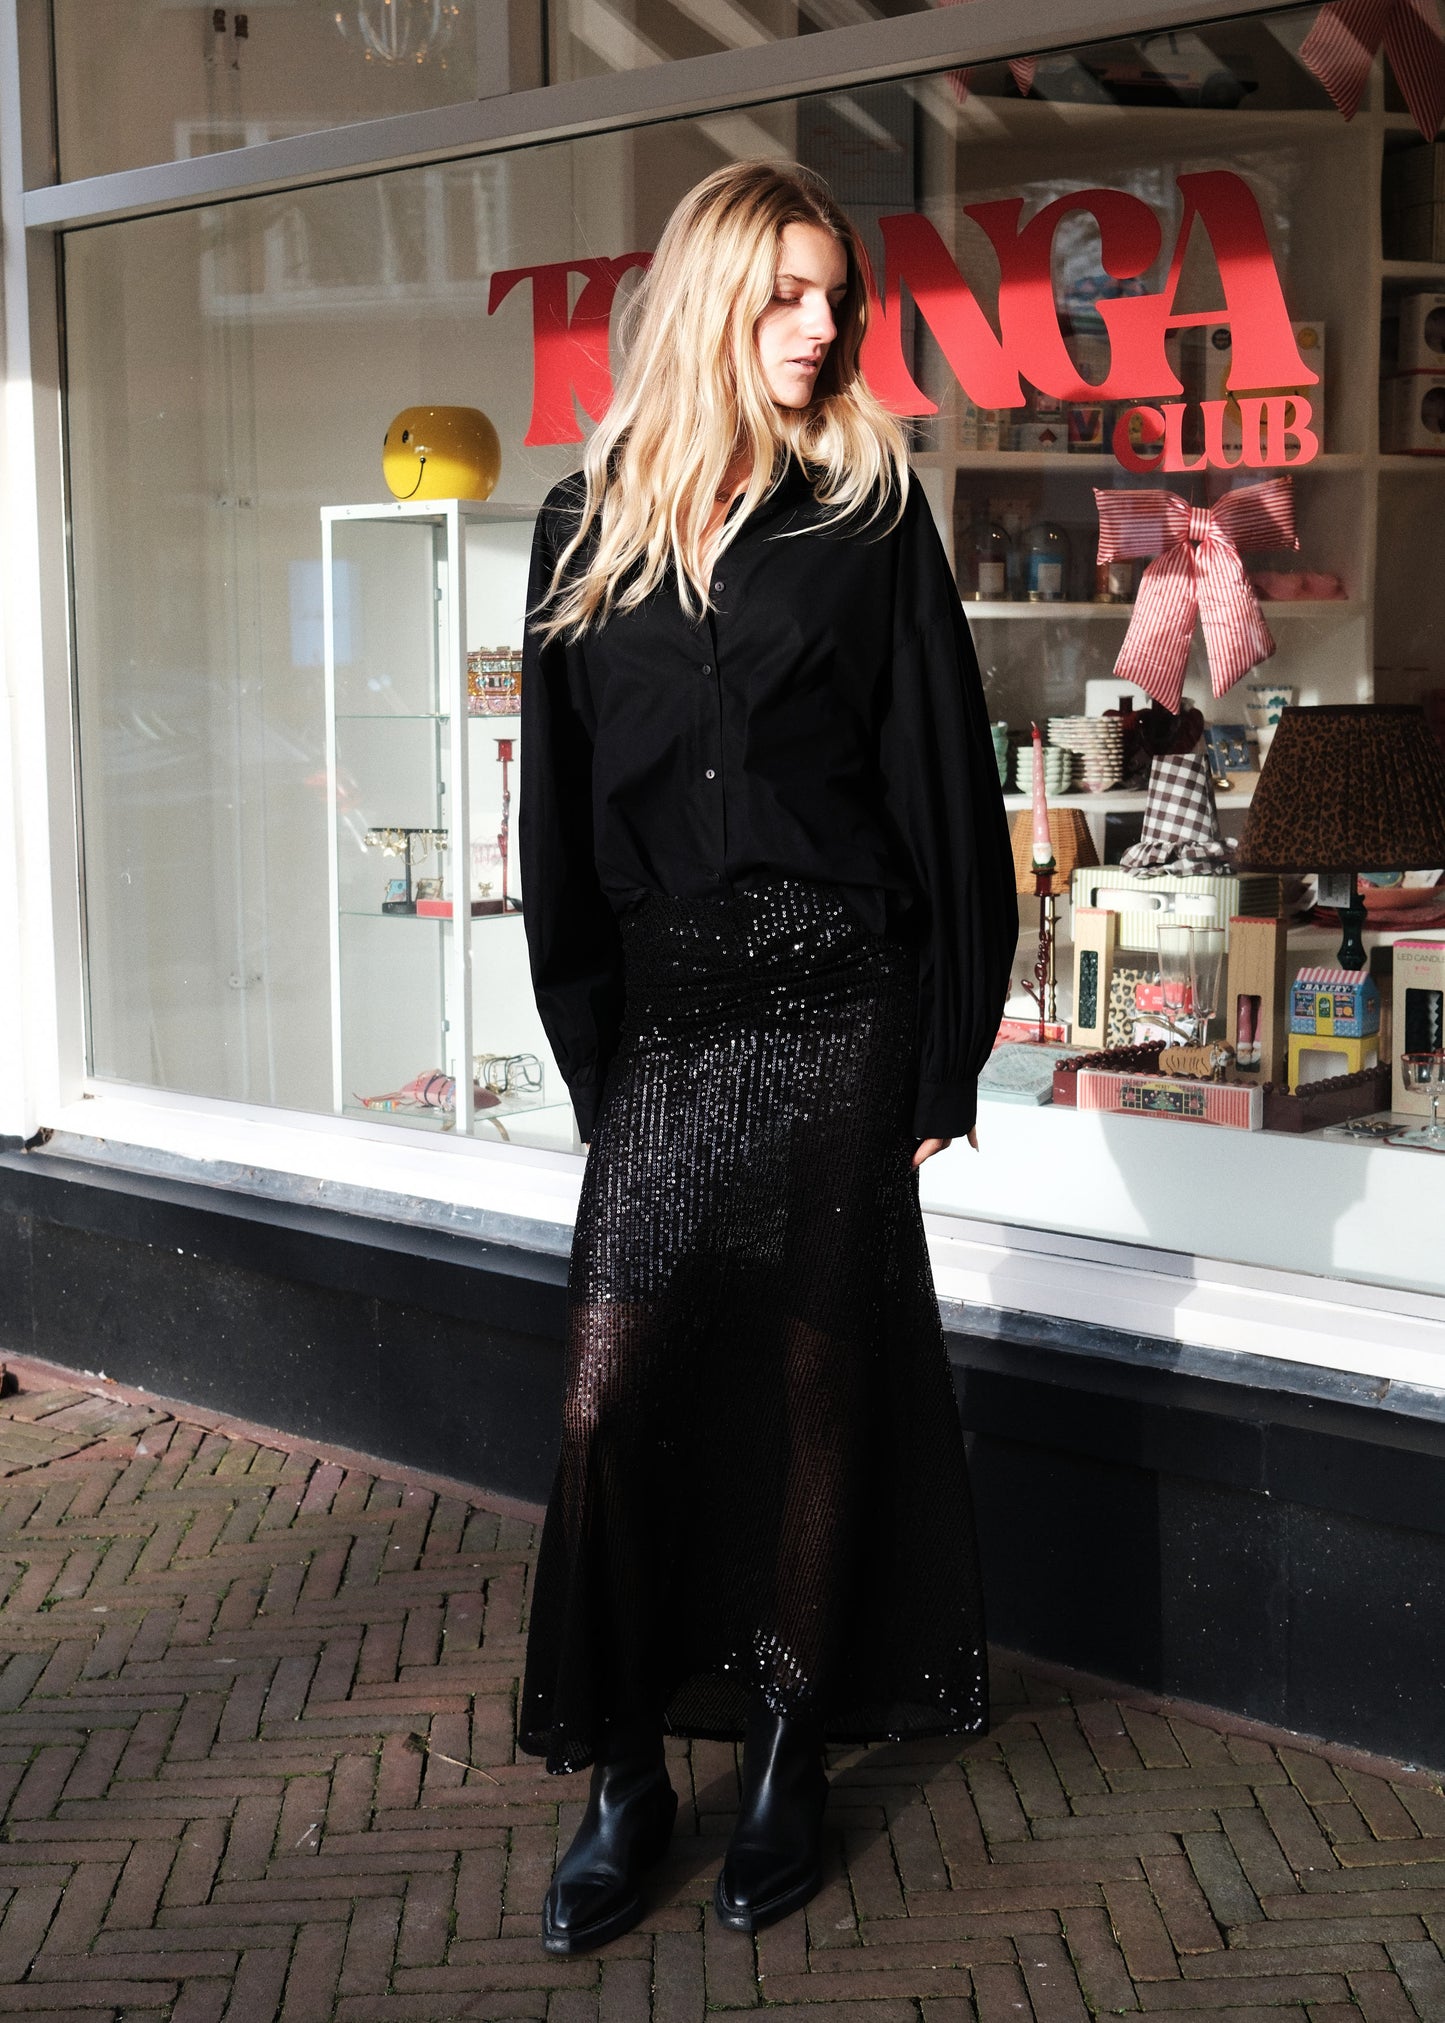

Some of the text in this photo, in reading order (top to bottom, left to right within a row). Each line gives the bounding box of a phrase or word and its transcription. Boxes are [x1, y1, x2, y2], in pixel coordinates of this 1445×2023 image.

[1112, 395, 1319, 474] CLUB
[1397, 952, 1413, 961] LED
[1304, 983, 1350, 993] BAKERY
